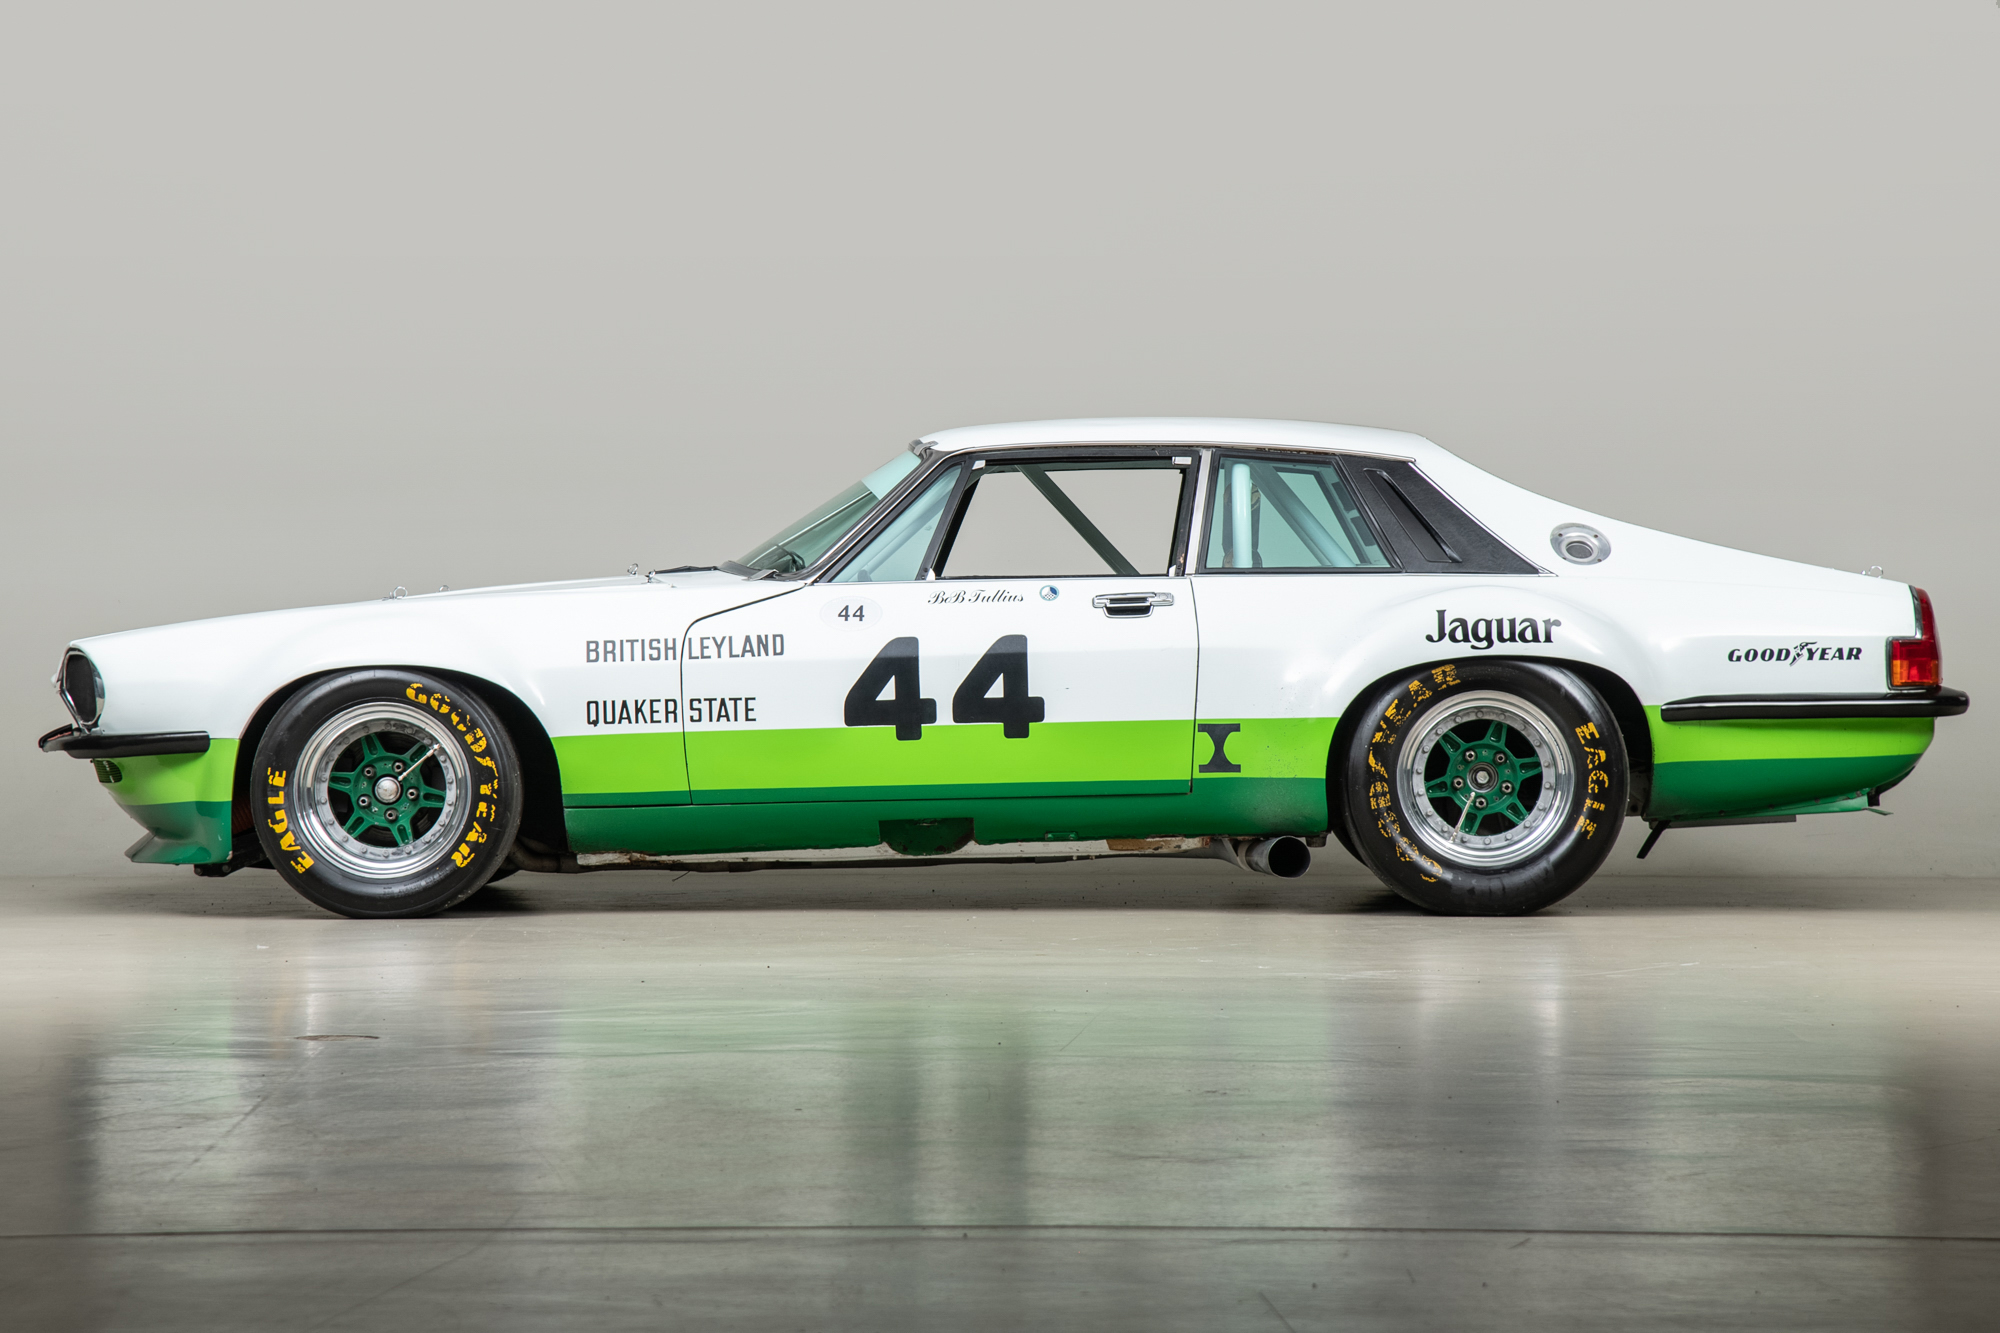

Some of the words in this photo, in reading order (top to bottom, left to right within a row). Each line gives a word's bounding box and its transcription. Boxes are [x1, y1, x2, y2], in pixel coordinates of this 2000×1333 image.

[968, 588, 1024, 603] Tullius
[837, 604, 865, 622] 44
[1425, 609, 1562, 650] Jaguar
[585, 637, 677, 663] BRITISH
[687, 633, 785, 660] LEYLAND
[844, 633, 1046, 741] 44
[586, 699, 678, 728] QUAKER
[688, 696, 757, 723] STATE
[267, 767, 315, 874] EAGLE
